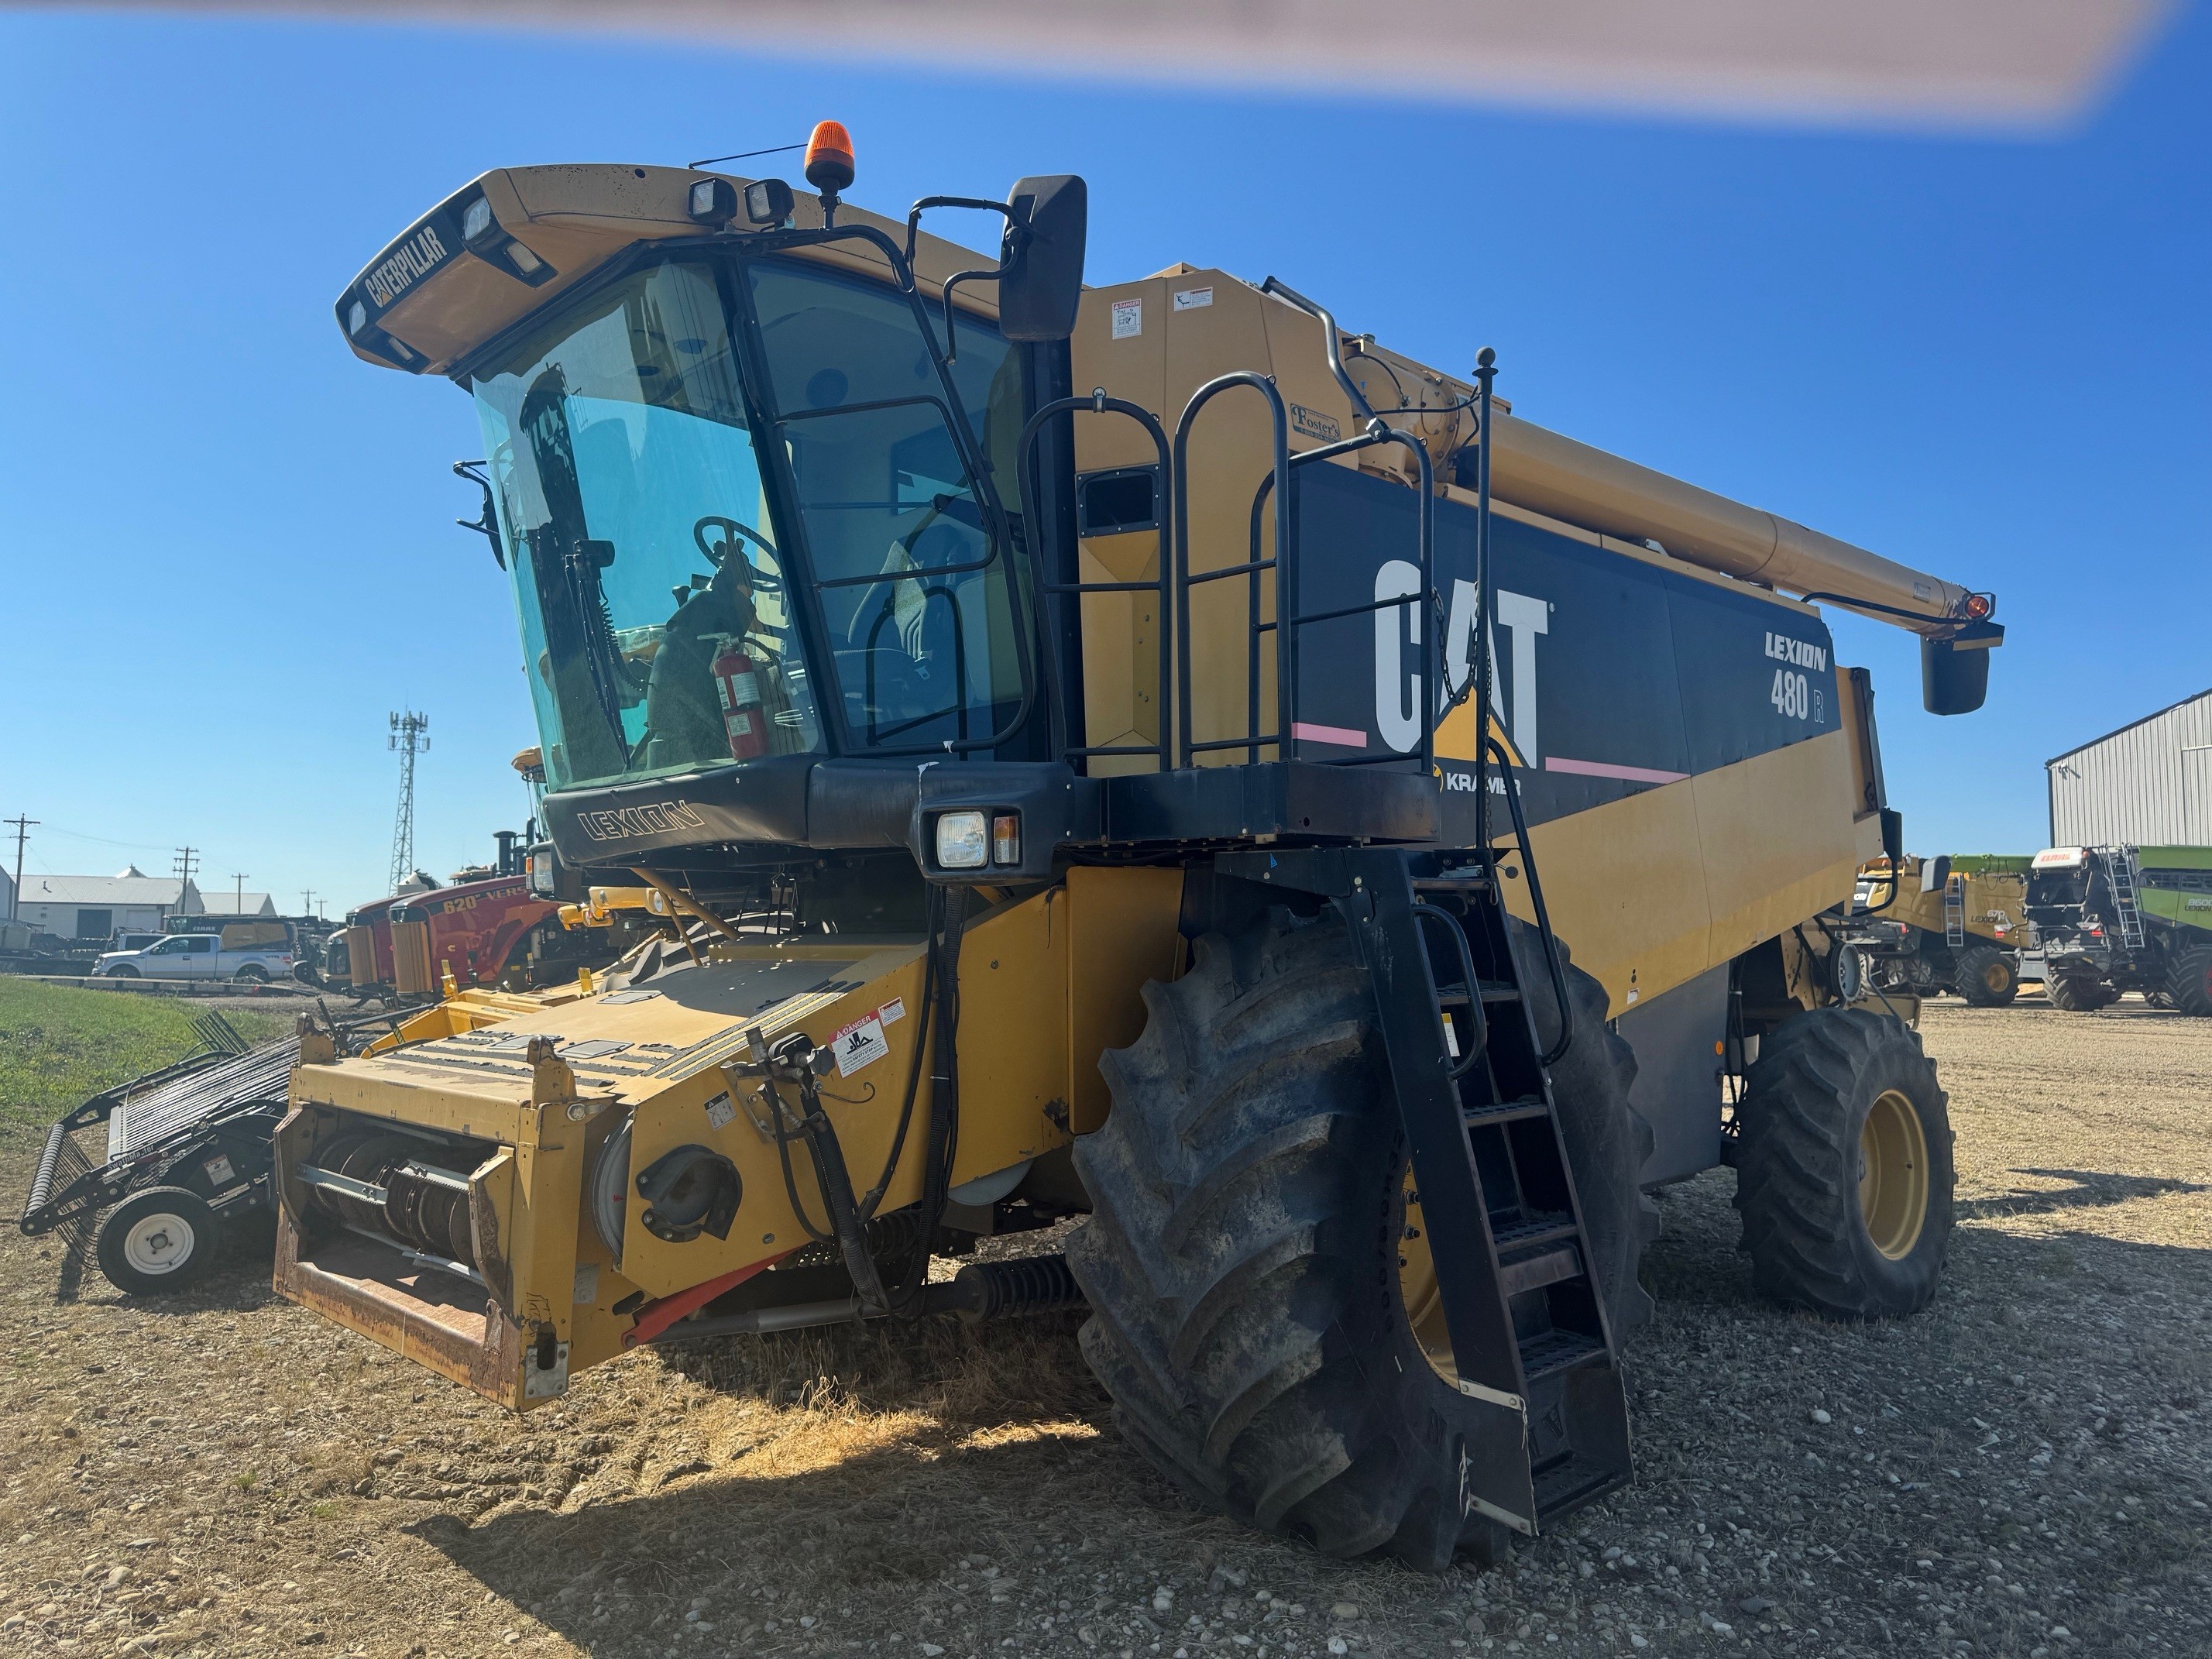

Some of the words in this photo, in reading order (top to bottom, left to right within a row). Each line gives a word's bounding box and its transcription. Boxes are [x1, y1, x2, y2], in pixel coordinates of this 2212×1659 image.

[365, 225, 448, 308] CATERPILLAR
[1292, 407, 1340, 437] Foster's
[1375, 559, 1548, 769] CAT
[1765, 631, 1826, 672] LEXION
[1771, 668, 1808, 720] 480
[1814, 689, 1824, 723] R
[577, 799, 706, 841] LEXION
[443, 895, 478, 914] 620
[843, 1015, 871, 1035] DANGER
[852, 1051, 865, 1061] SAFETY
[108, 1145, 154, 1171] SwathMaster
